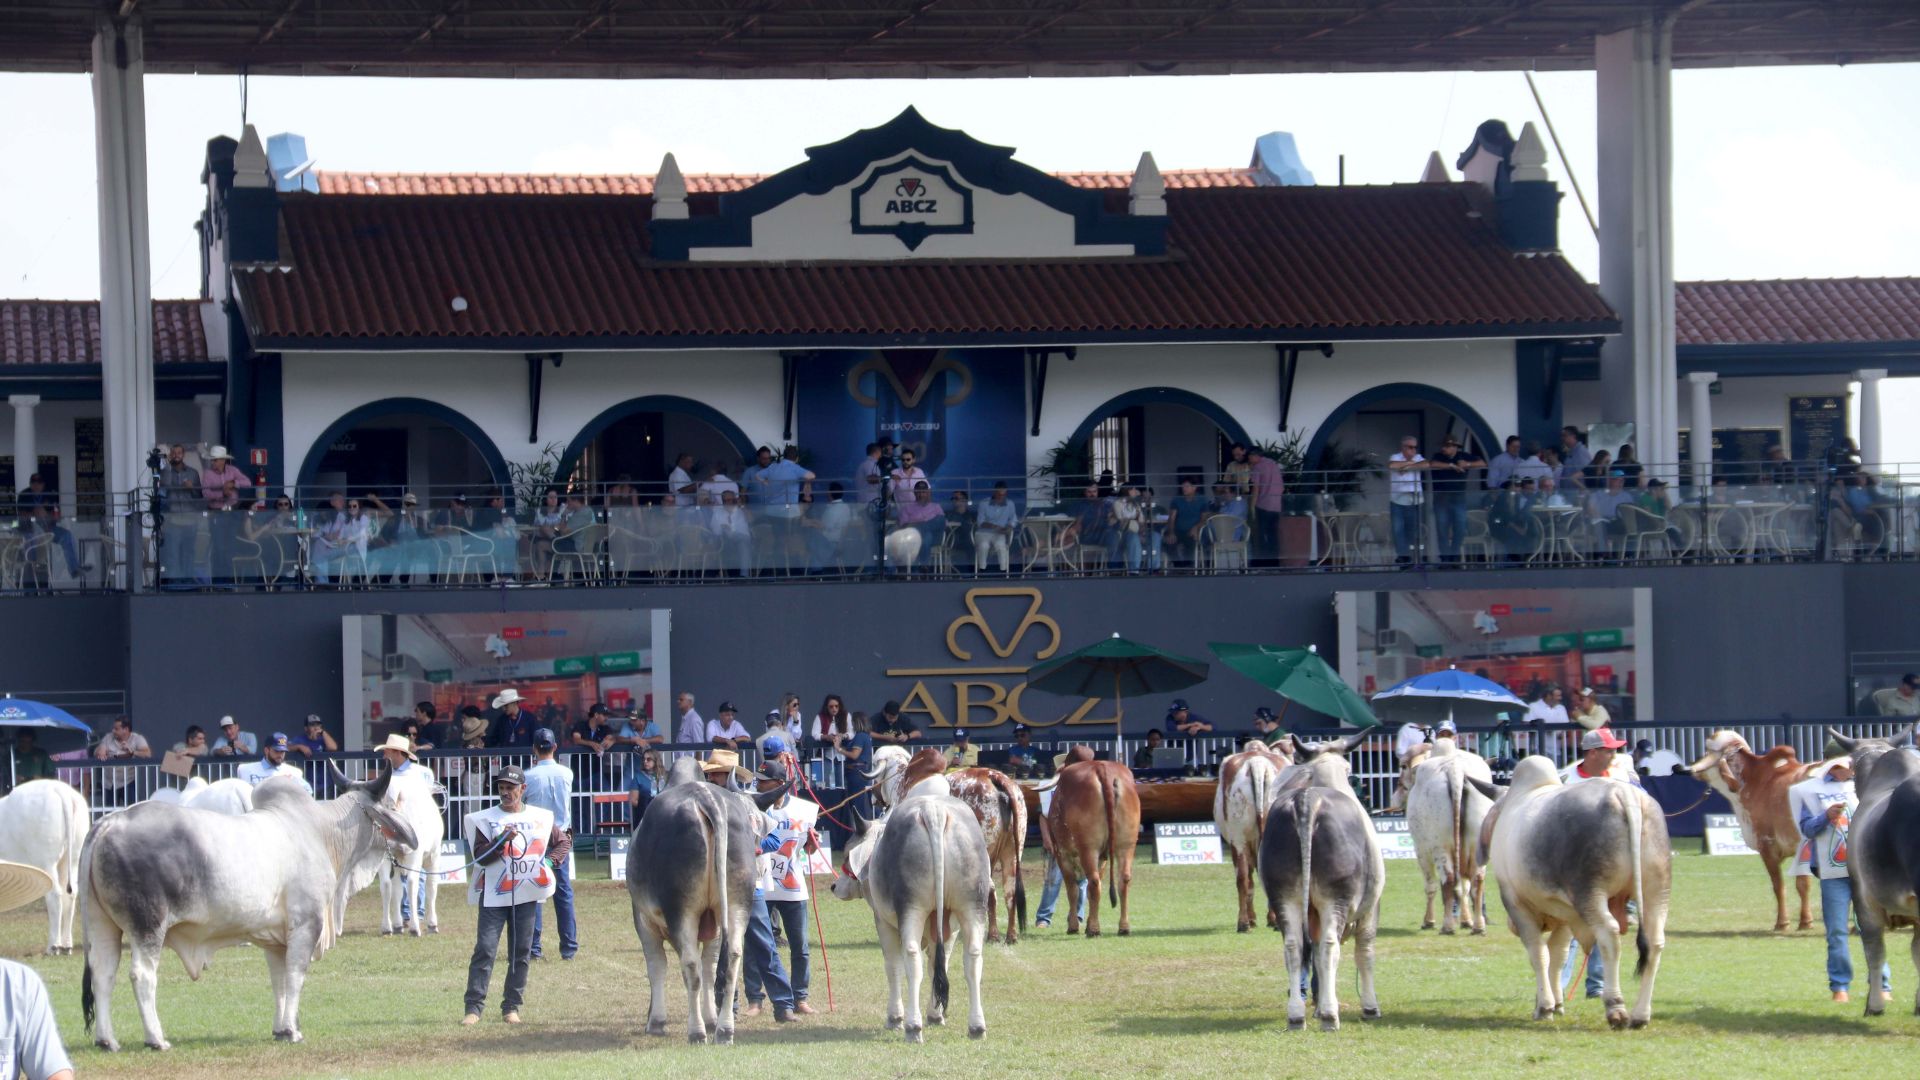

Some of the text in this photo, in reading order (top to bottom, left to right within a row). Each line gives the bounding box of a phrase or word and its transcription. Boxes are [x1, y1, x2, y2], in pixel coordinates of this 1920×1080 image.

[885, 200, 937, 213] ABCZ
[1178, 824, 1216, 835] LUGAR
[1394, 821, 1409, 832] LU
[441, 843, 457, 854] AR
[1163, 851, 1216, 862] PremiX
[510, 860, 536, 874] 007
